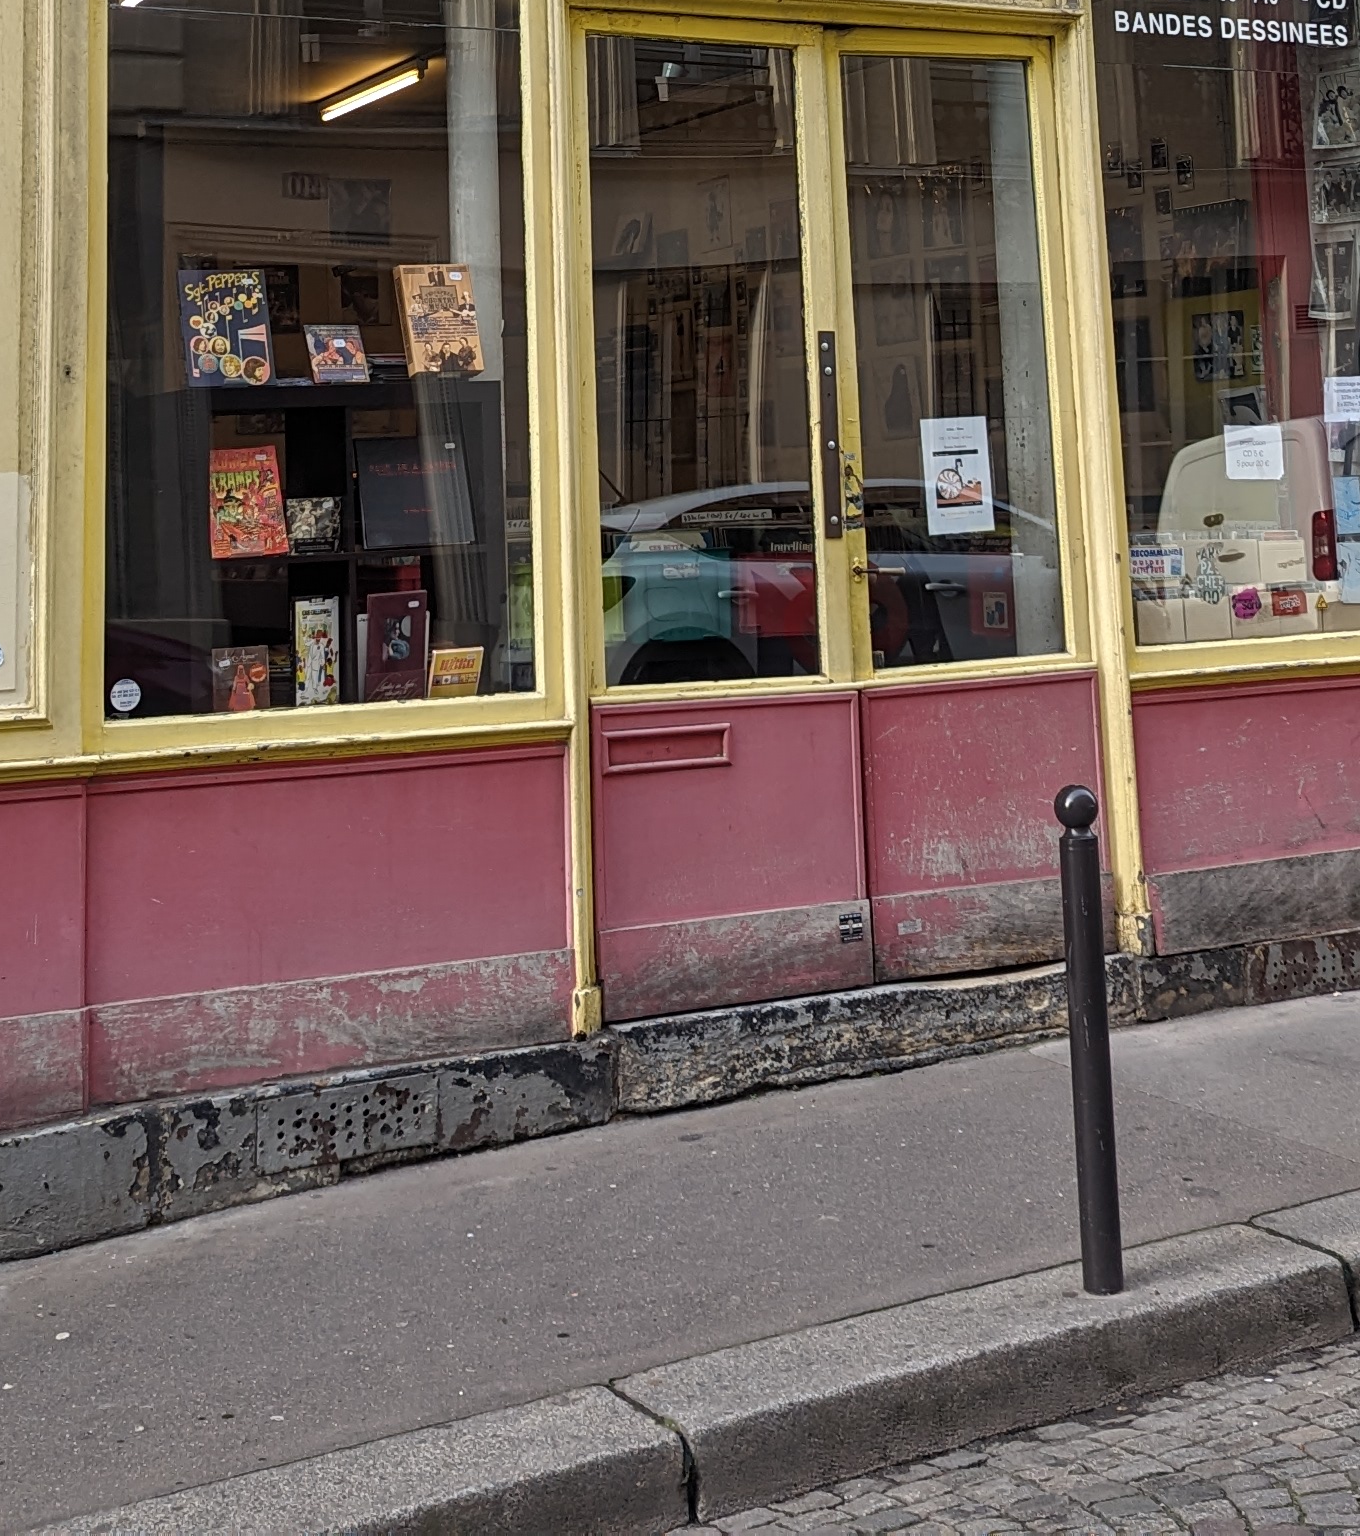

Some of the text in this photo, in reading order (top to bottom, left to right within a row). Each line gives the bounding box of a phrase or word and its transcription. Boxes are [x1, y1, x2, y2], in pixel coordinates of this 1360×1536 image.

[1114, 10, 1348, 46] BANDES DESSINEES
[1242, 449, 1252, 457] CD
[212, 469, 260, 490] CRAMPS
